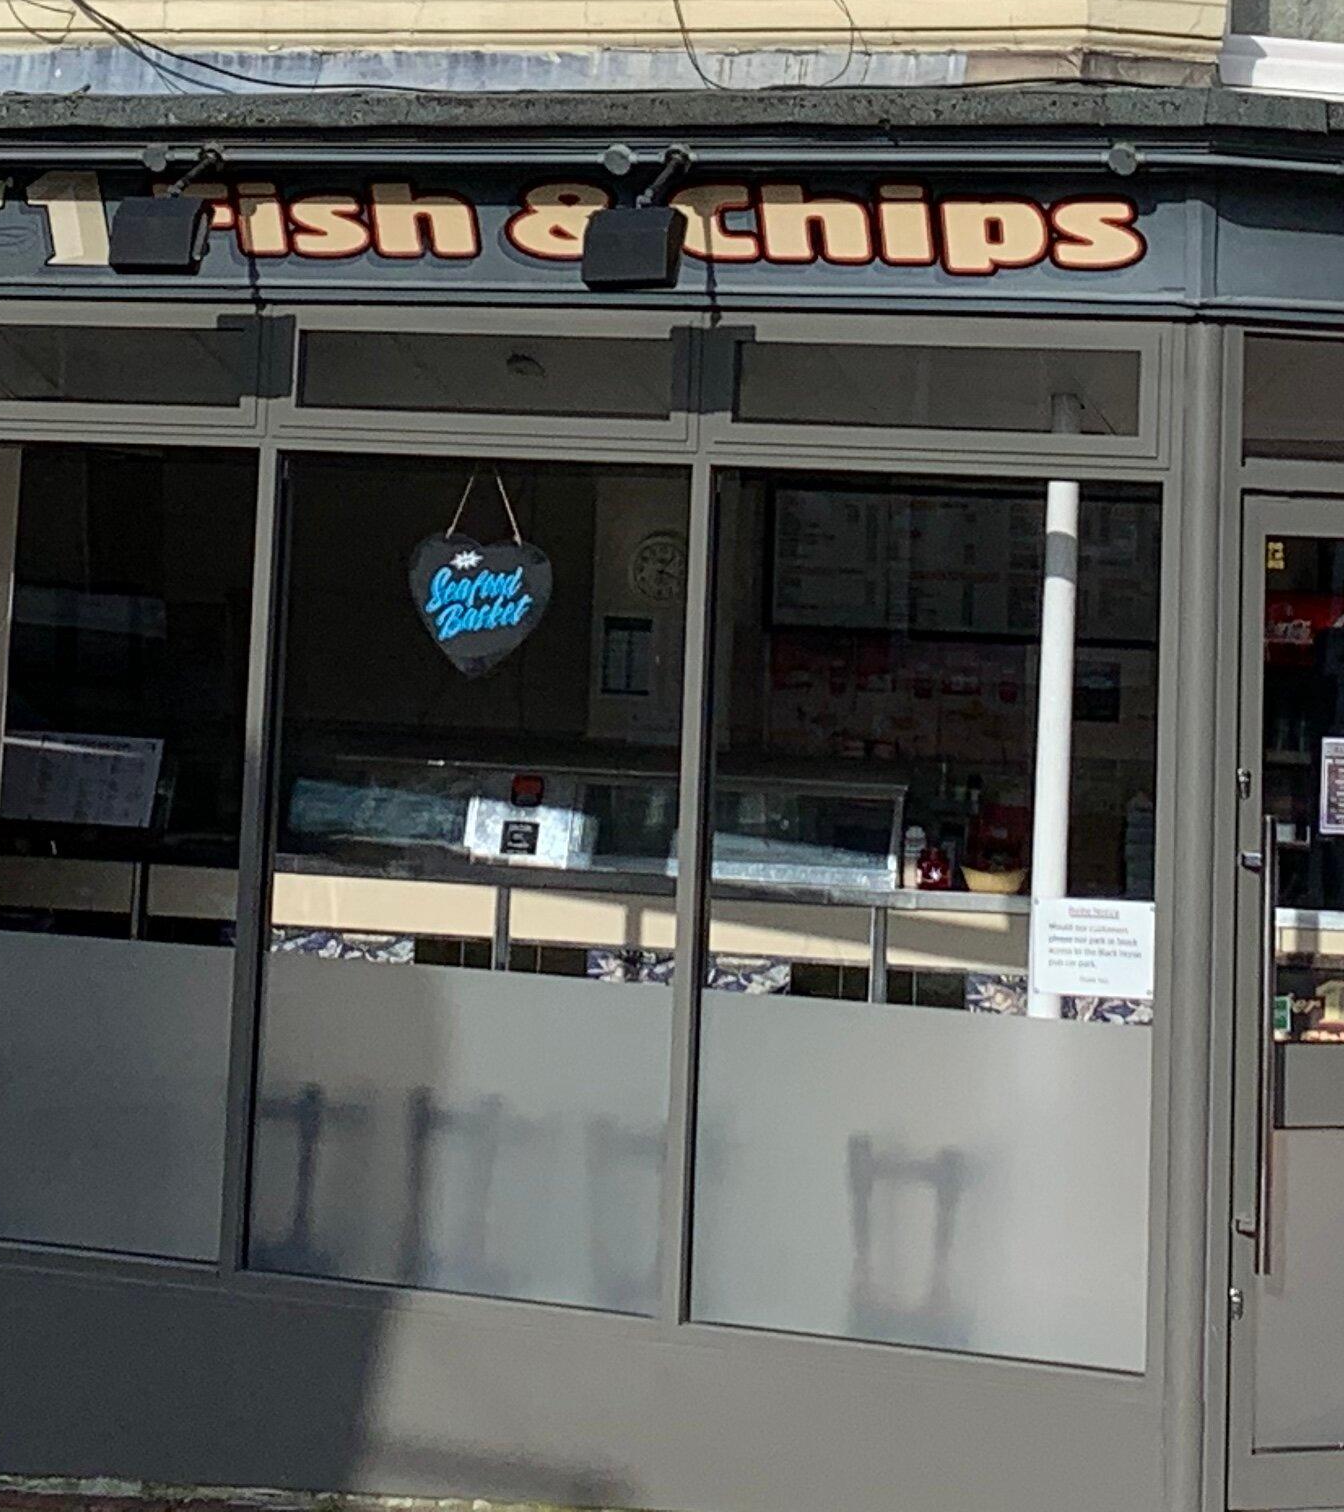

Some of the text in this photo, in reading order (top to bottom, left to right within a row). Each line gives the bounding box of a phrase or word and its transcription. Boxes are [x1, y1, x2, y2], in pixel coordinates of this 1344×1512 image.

[25, 170, 110, 266] 1
[504, 181, 618, 260] &
[666, 181, 1149, 277] Chips
[425, 566, 523, 614] Seafood
[436, 594, 534, 641] Basket
